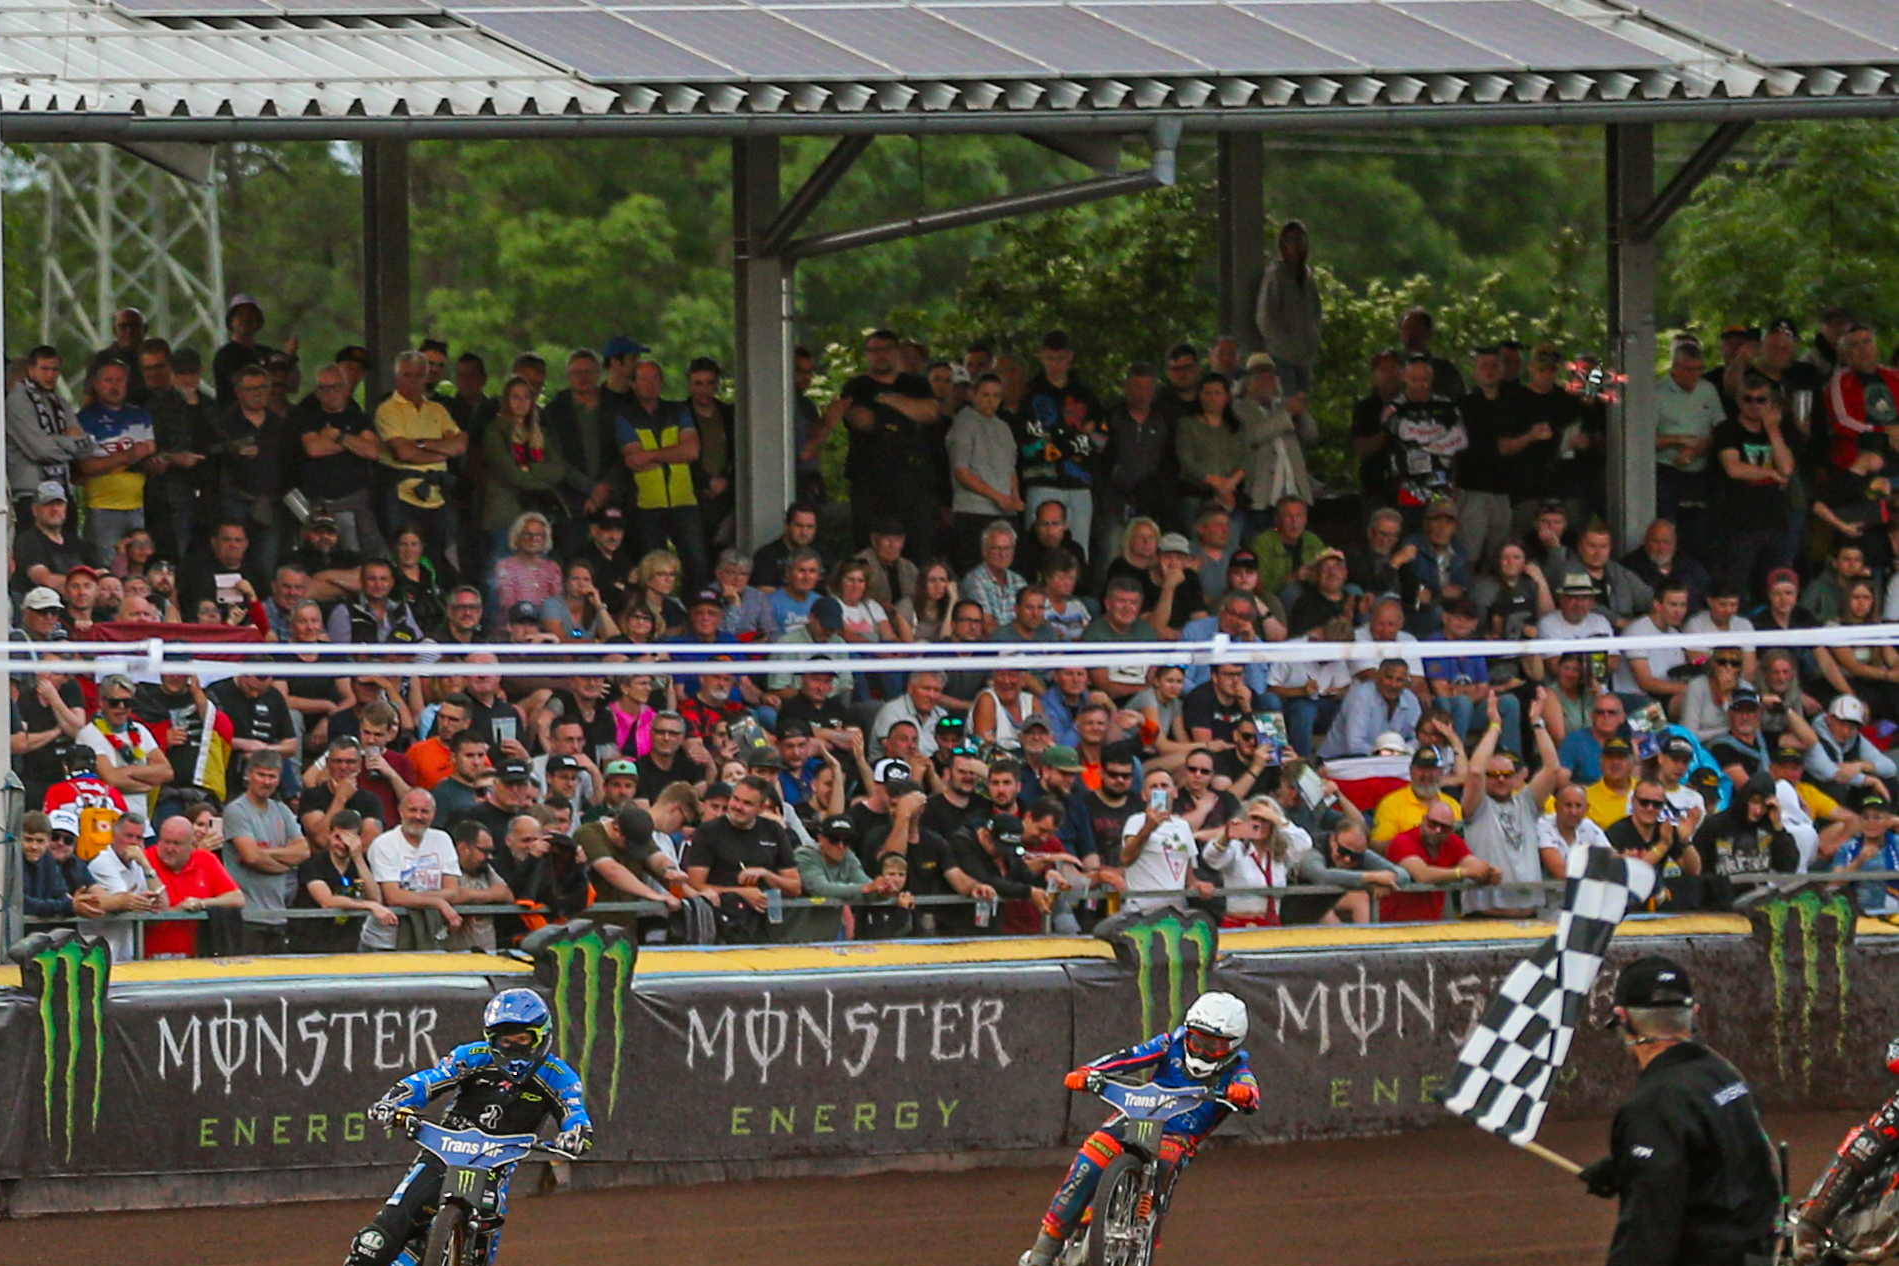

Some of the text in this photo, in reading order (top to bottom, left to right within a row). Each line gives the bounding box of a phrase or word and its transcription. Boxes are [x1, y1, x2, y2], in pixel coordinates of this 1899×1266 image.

[158, 997, 440, 1094] MONSTER
[686, 991, 1012, 1084] MONSTER
[1124, 1091, 1156, 1107] Trans
[201, 1111, 394, 1147] ENERG
[731, 1099, 959, 1136] ENERGY
[441, 1137, 480, 1156] Trans
